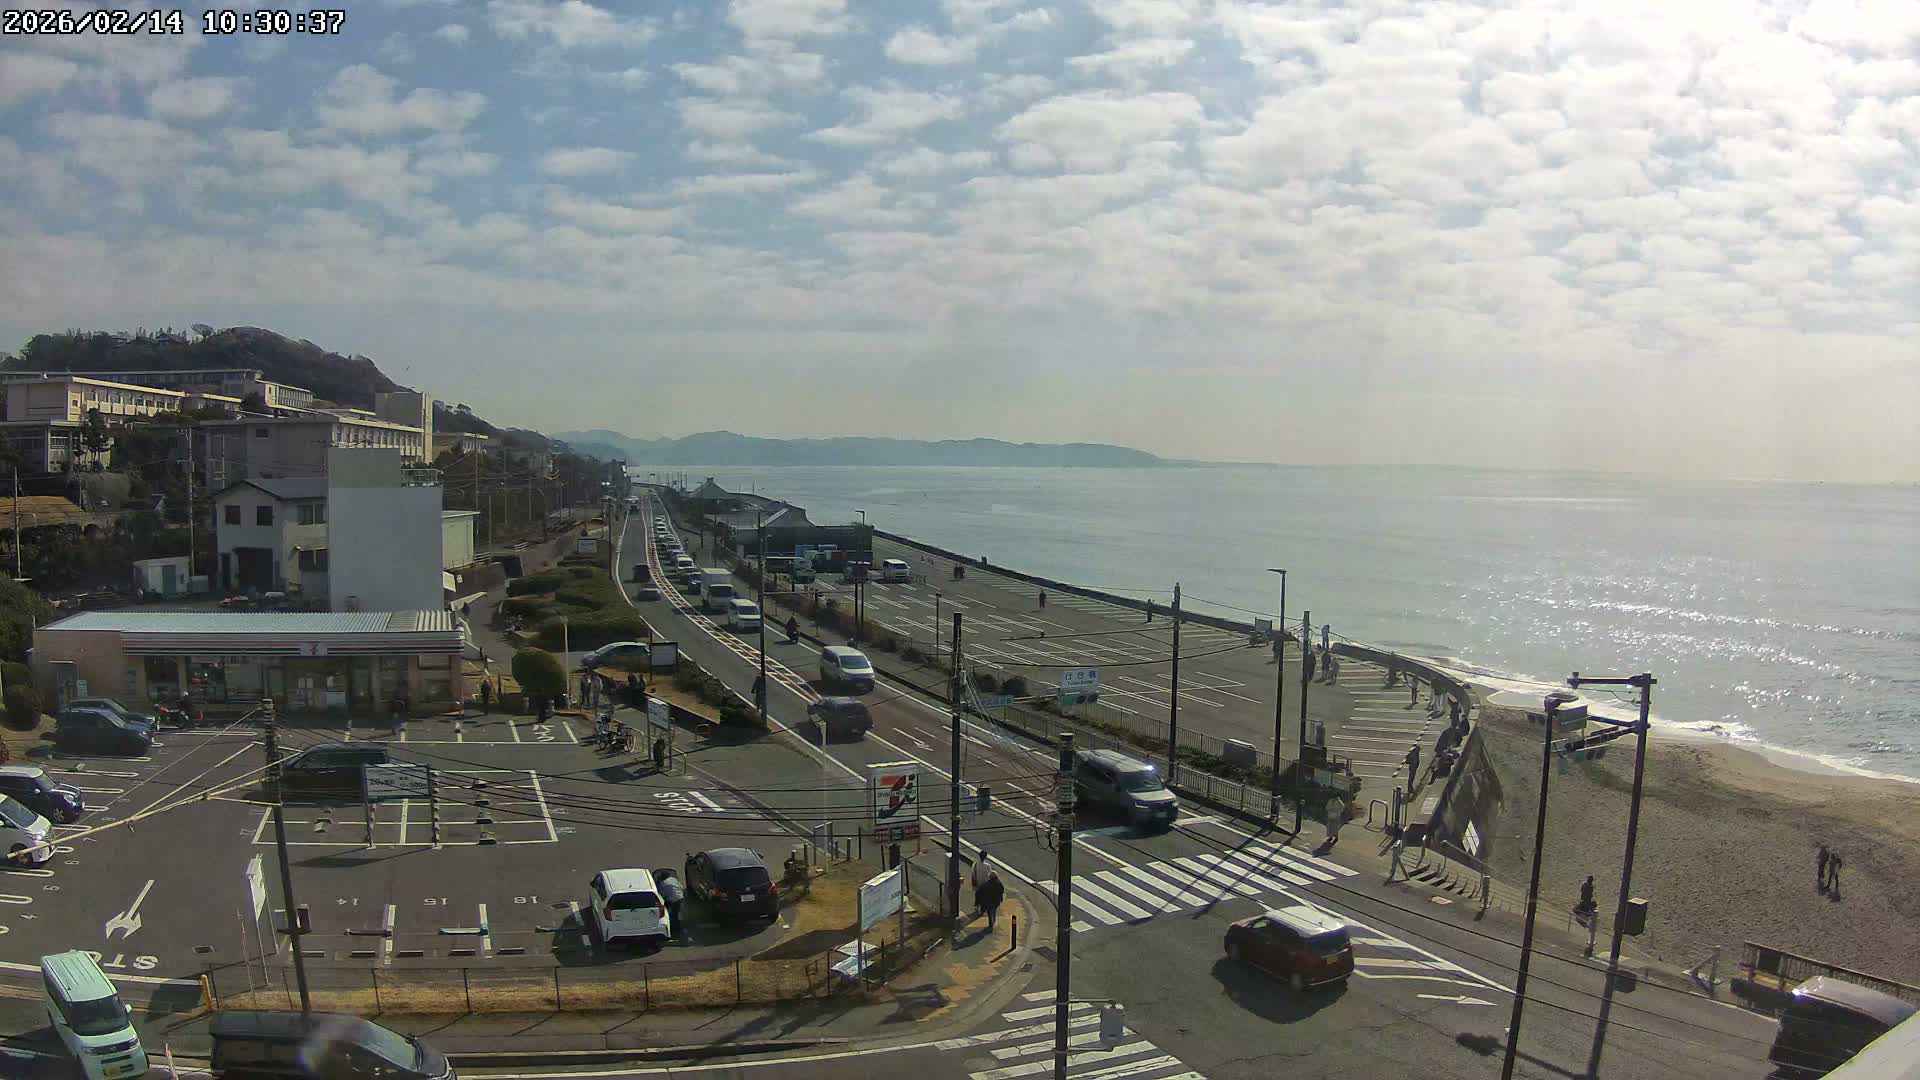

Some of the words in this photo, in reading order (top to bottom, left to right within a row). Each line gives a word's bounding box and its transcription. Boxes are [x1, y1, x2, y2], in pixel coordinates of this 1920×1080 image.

[652, 792, 703, 813] STOP
[336, 898, 360, 906] 14
[423, 897, 448, 906] 15
